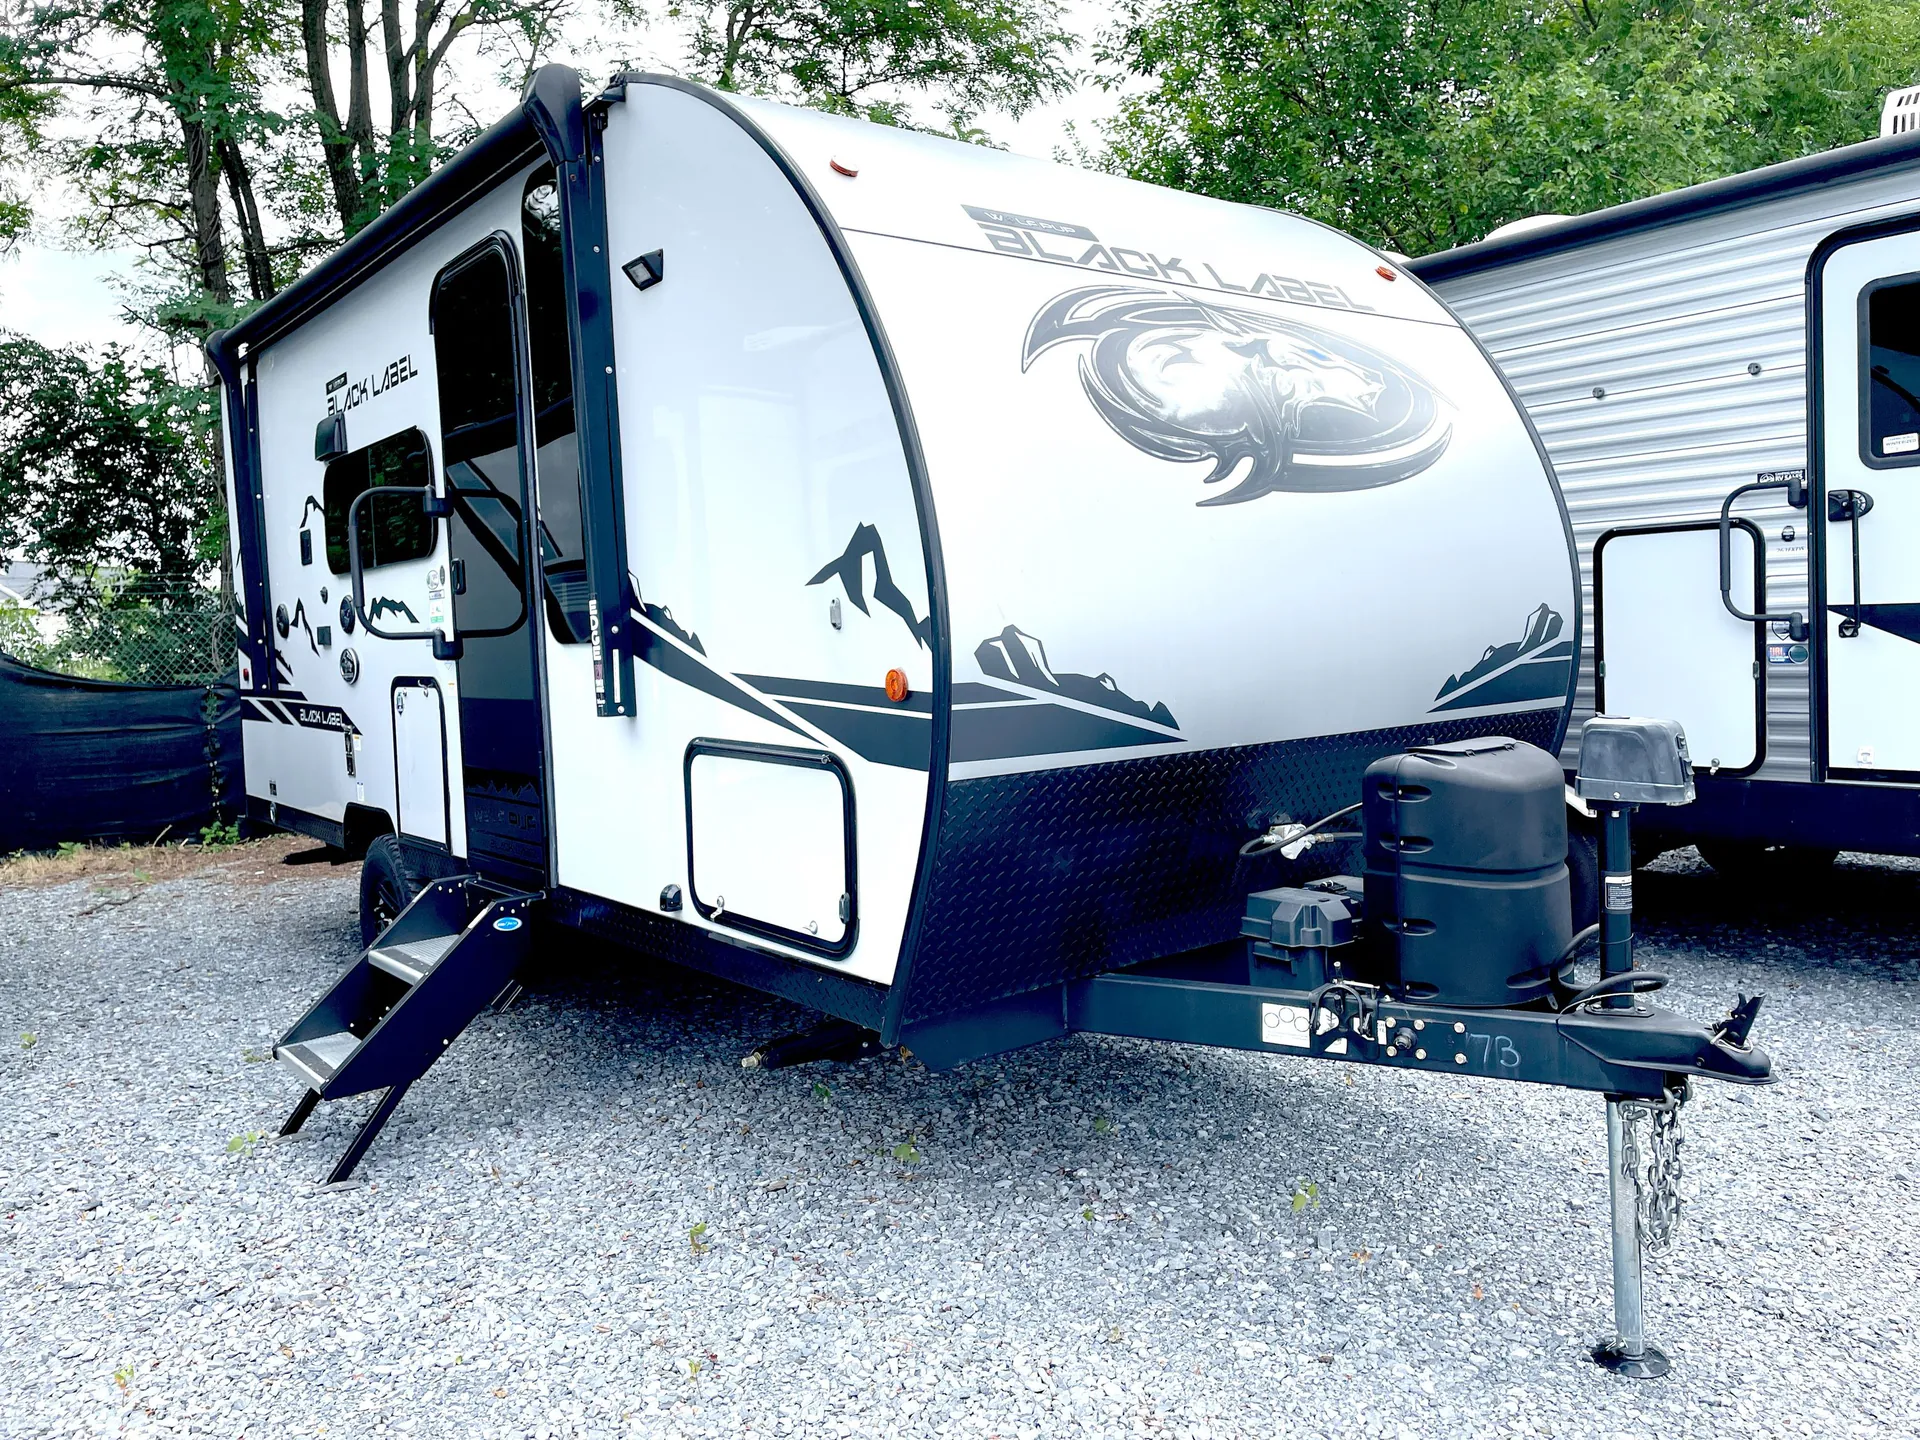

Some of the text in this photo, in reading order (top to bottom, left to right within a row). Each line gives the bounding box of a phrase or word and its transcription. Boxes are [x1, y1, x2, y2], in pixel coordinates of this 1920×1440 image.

[1039, 221, 1076, 234] PUP
[976, 221, 1377, 312] BLACK LABEL
[327, 377, 369, 417] BLACK
[371, 353, 418, 397] LABEL
[588, 599, 602, 660] EDGE
[299, 708, 346, 728] BLACK LABEL
